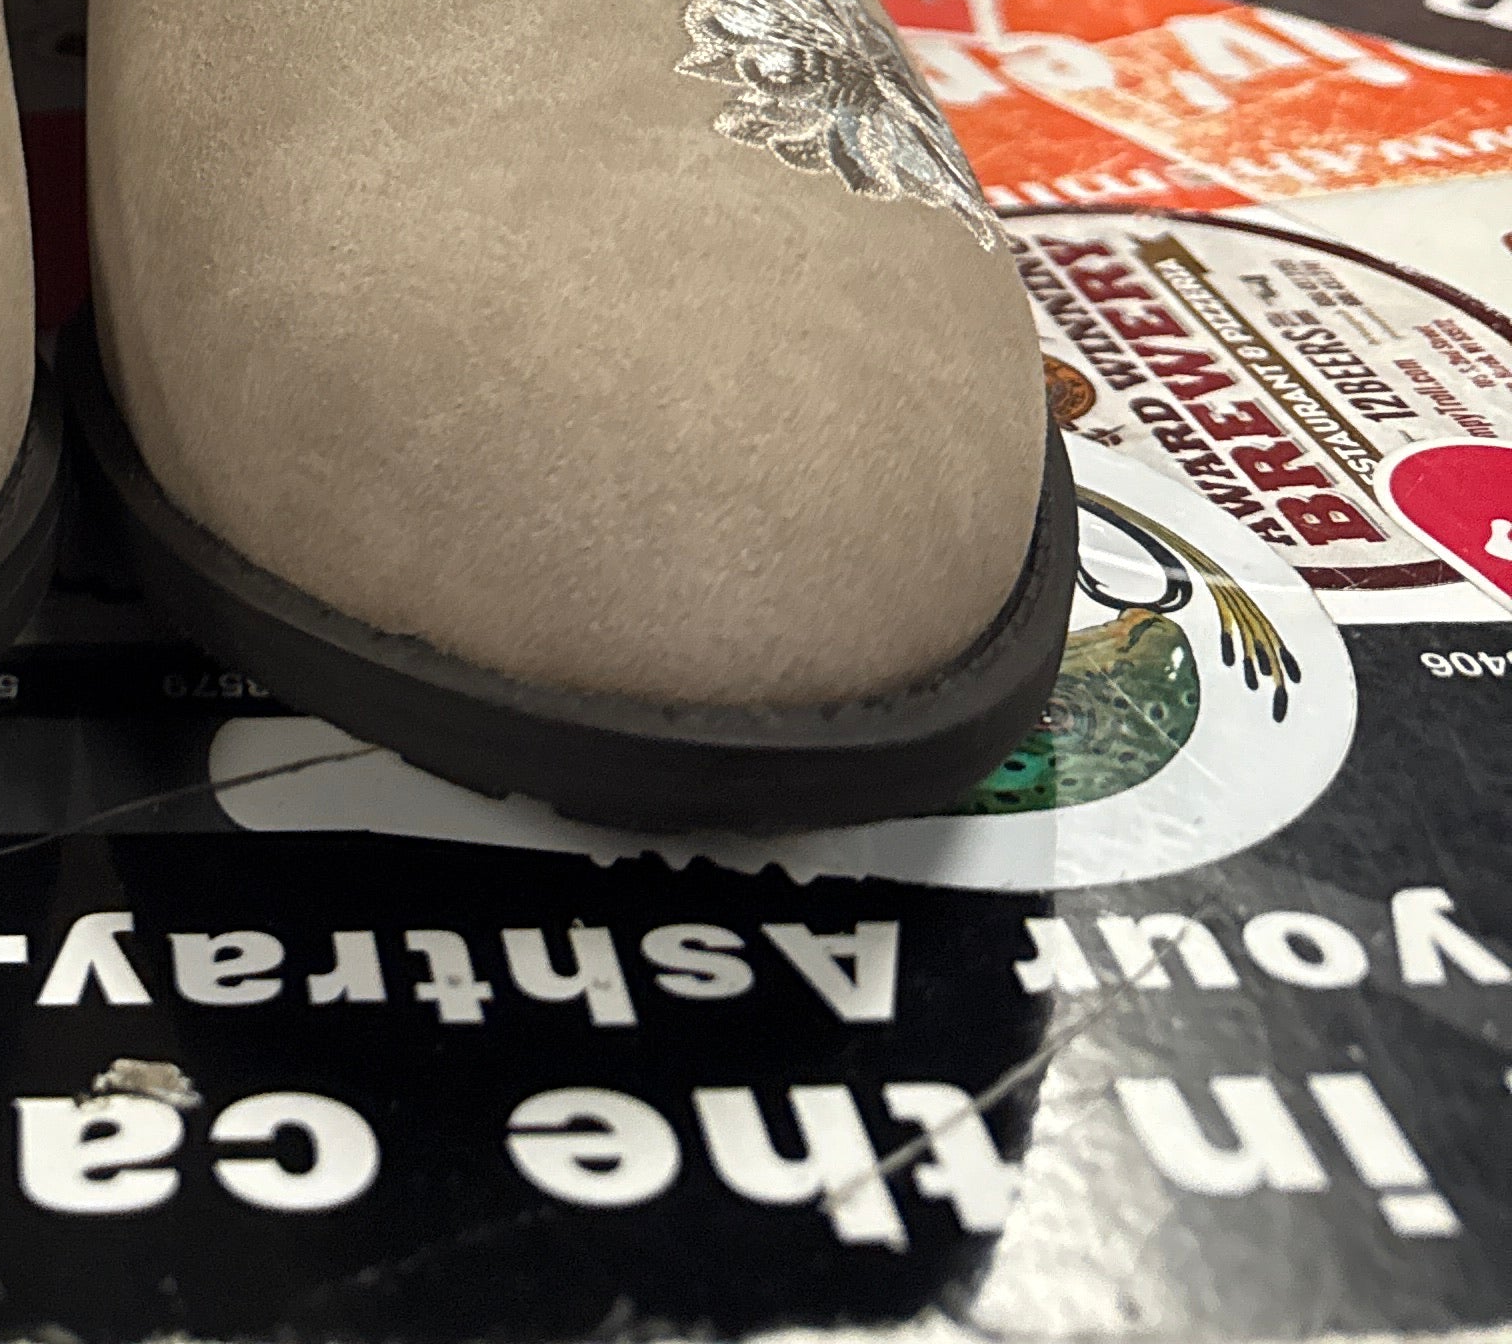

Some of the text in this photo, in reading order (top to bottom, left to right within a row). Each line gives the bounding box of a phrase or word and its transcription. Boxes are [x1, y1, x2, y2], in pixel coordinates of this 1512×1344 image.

[1039, 237, 1392, 546] BREWERY
[1129, 397, 1296, 548] AWARD
[1421, 652, 1512, 678] 406
[1011, 886, 1512, 993] your
[505, 1081, 1024, 1250] the
[1116, 1072, 1461, 1237] in
